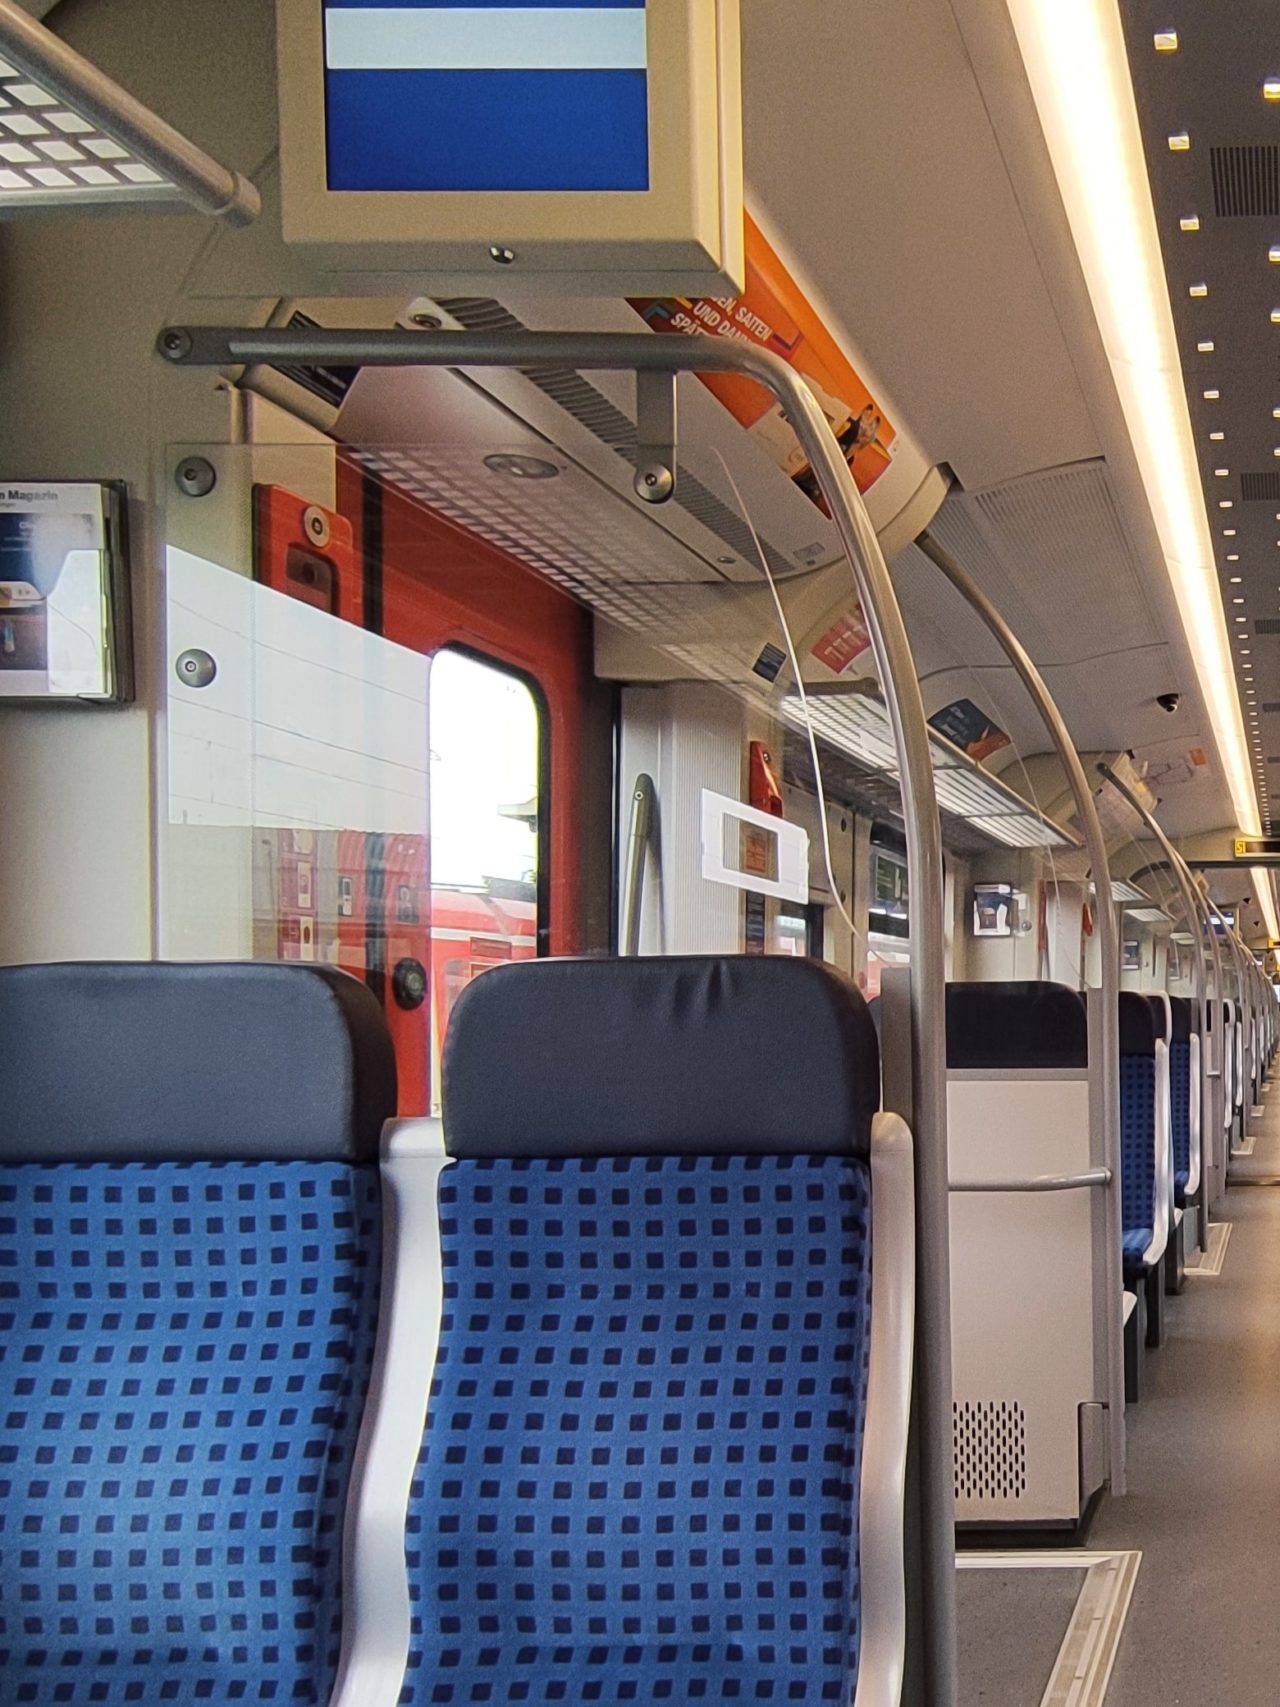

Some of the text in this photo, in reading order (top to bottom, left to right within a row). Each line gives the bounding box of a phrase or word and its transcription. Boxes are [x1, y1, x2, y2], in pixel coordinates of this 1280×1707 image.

[693, 300, 720, 327] UND
[735, 306, 773, 341] SAITEN
[8, 490, 58, 502] Magazin
